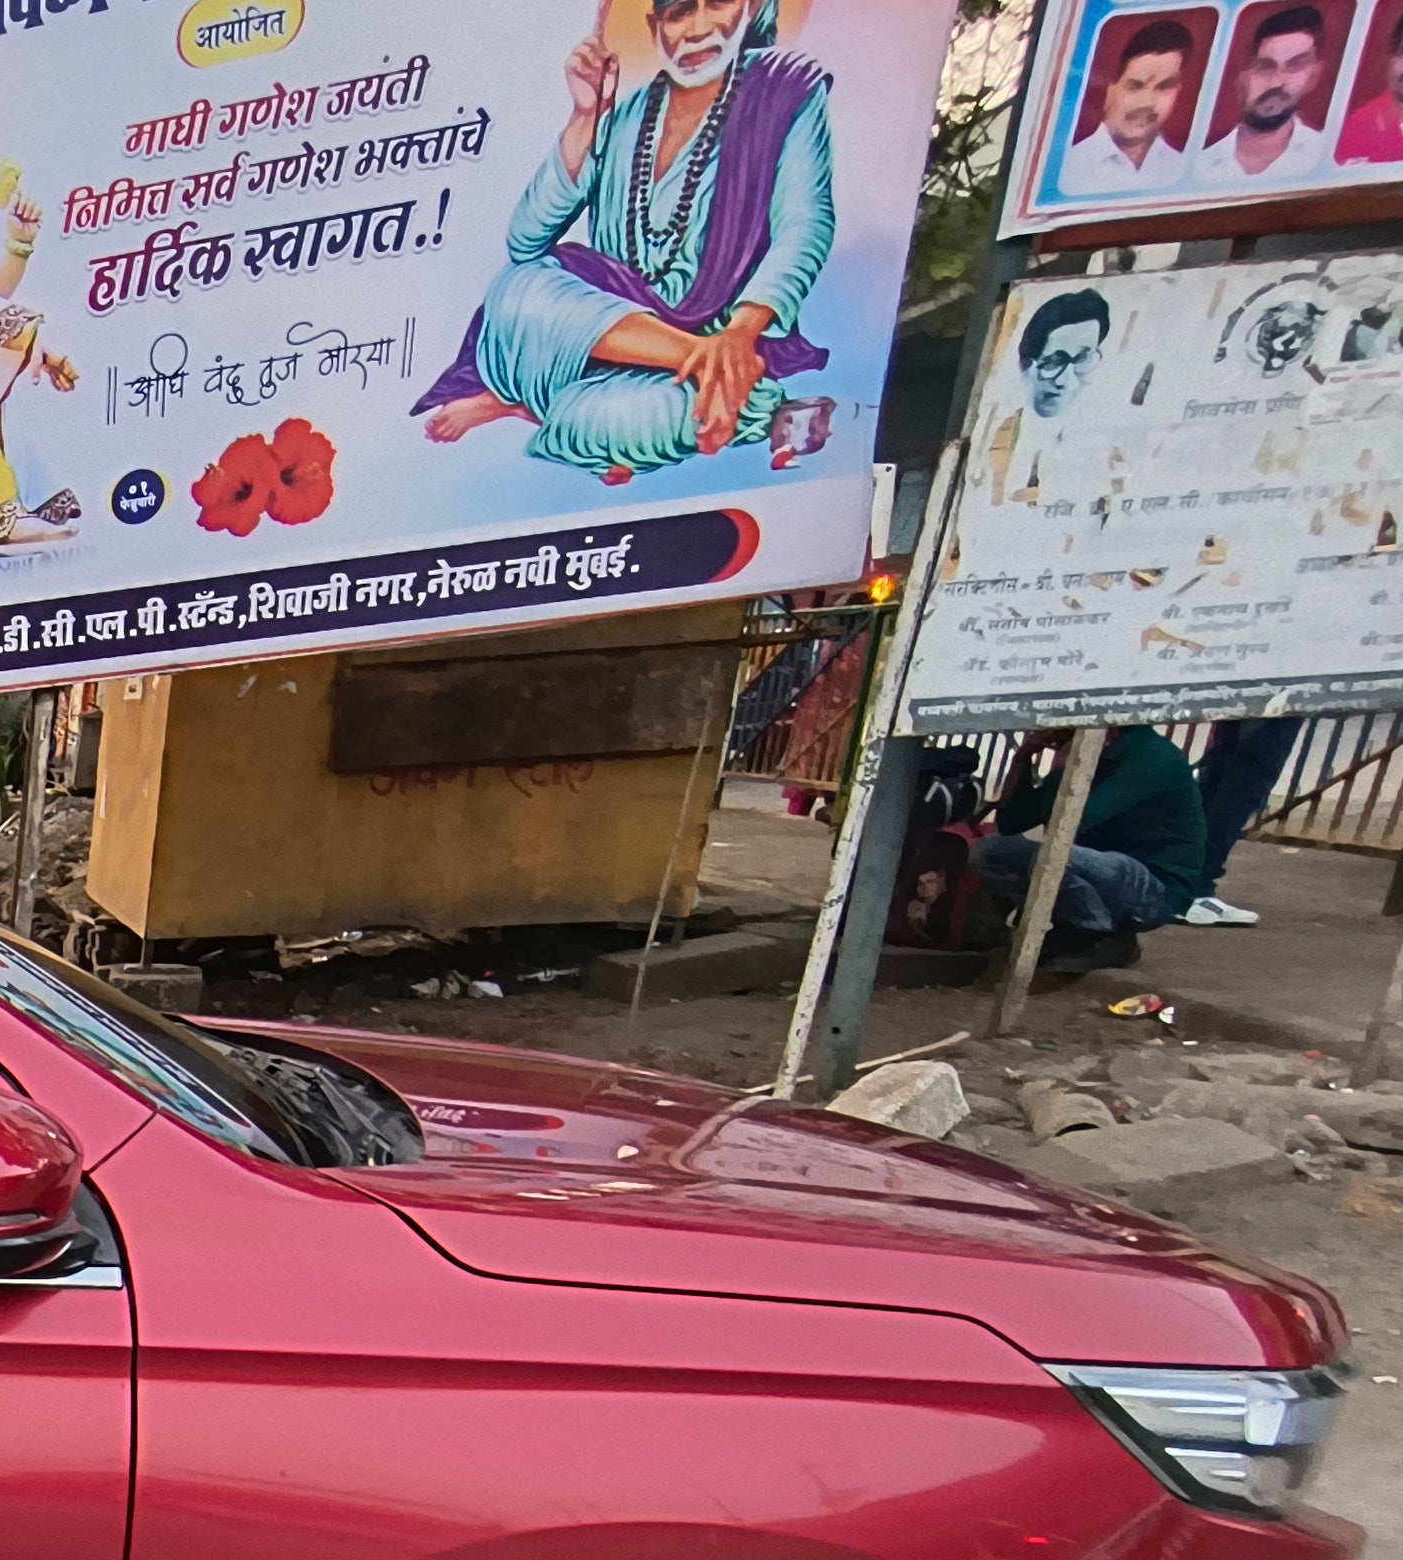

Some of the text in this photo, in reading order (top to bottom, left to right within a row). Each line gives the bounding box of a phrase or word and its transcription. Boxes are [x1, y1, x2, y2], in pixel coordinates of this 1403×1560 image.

[195, 9, 286, 49] आयोजित
[125, 54, 431, 157] माघी गणेश जयंती
[63, 106, 491, 234] निमित्त सर्व गणेश भक्तांचे
[88, 221, 234, 313] हार्दिक
[504, 545, 561, 589] नवी
